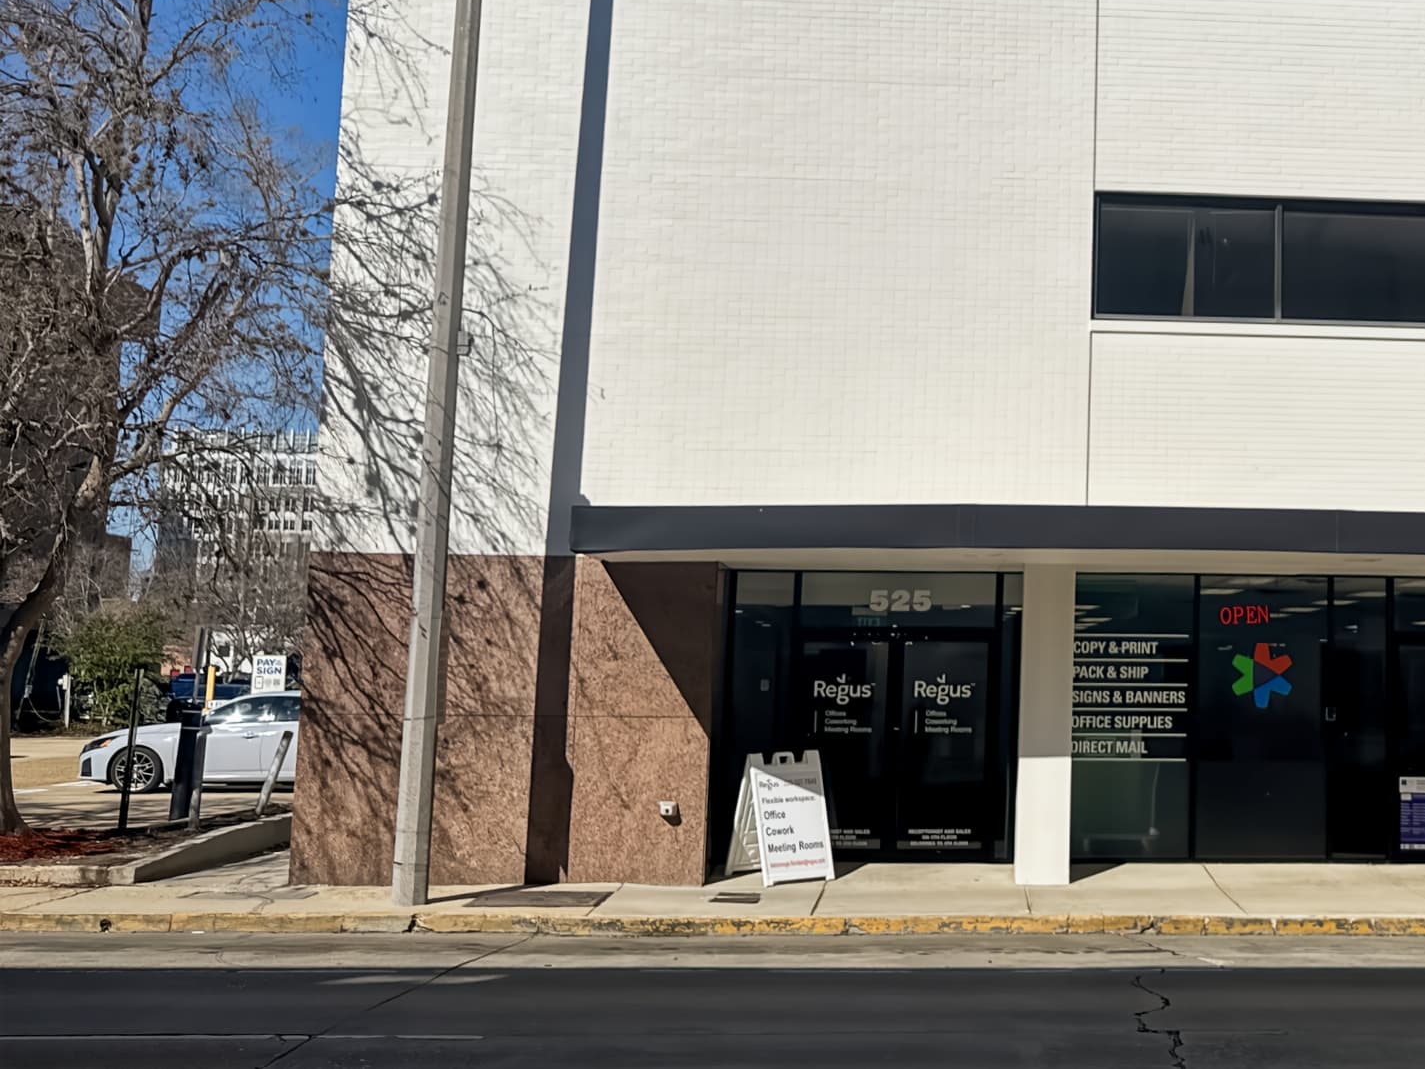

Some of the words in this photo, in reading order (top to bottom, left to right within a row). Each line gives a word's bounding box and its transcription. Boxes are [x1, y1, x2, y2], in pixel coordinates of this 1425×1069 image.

[869, 589, 933, 612] 525
[1219, 605, 1270, 625] OPEN
[1073, 641, 1106, 655] COPY
[1108, 641, 1119, 655] &
[1121, 641, 1159, 655] PRINT
[256, 658, 276, 666] PAY
[256, 666, 282, 675] SIGN
[1073, 666, 1104, 679] PACK
[1106, 666, 1117, 679] &
[1119, 666, 1149, 679] SHIP
[813, 673, 873, 705] Regus
[913, 673, 973, 705] Regus
[1072, 690, 1110, 704] SIGNS
[1112, 690, 1123, 704] &
[1125, 690, 1186, 704] BANNERS
[1071, 715, 1112, 729] OFFICE
[1114, 715, 1173, 729] SUPPLIES
[1071, 740, 1115, 754] DIRECT
[1116, 740, 1149, 754] MAIL
[763, 810, 786, 820] Office
[766, 825, 795, 836] Cowork
[767, 842, 797, 854] Meeting
[798, 840, 825, 851] Rooms
